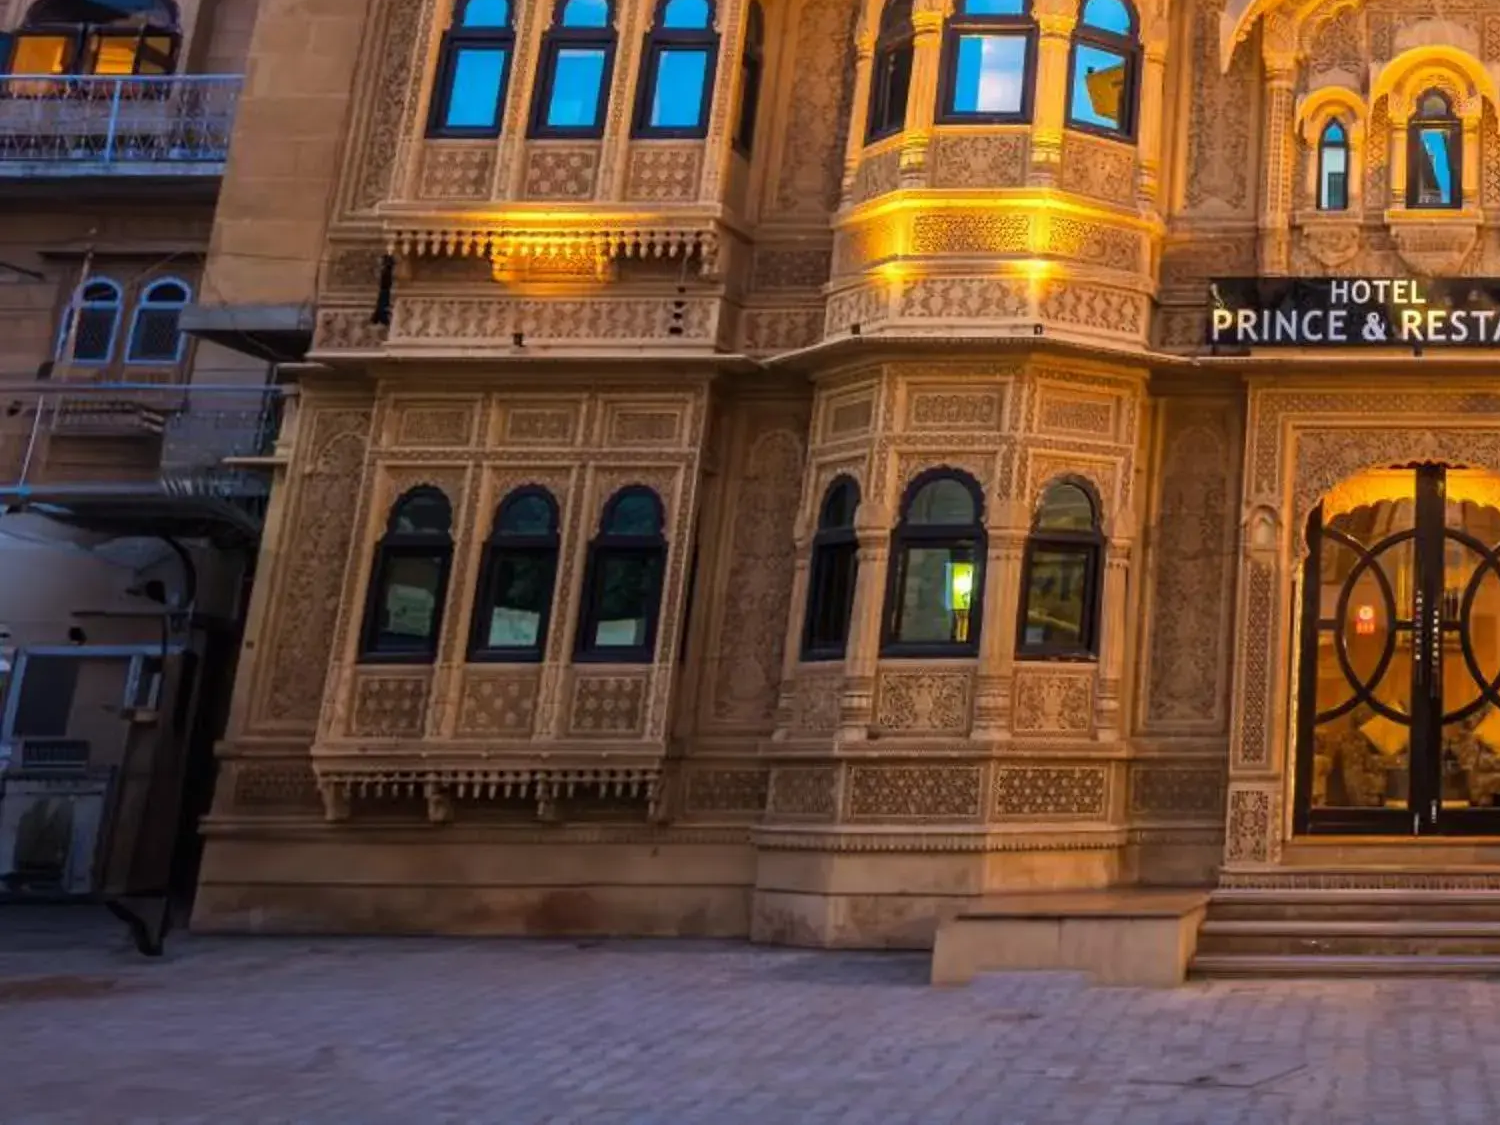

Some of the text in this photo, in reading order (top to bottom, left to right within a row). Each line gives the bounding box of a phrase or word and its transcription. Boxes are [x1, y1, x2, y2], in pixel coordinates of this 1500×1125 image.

[1330, 279, 1426, 304] HOTEL
[1211, 309, 1348, 342] PRINCE
[1361, 312, 1387, 342] &
